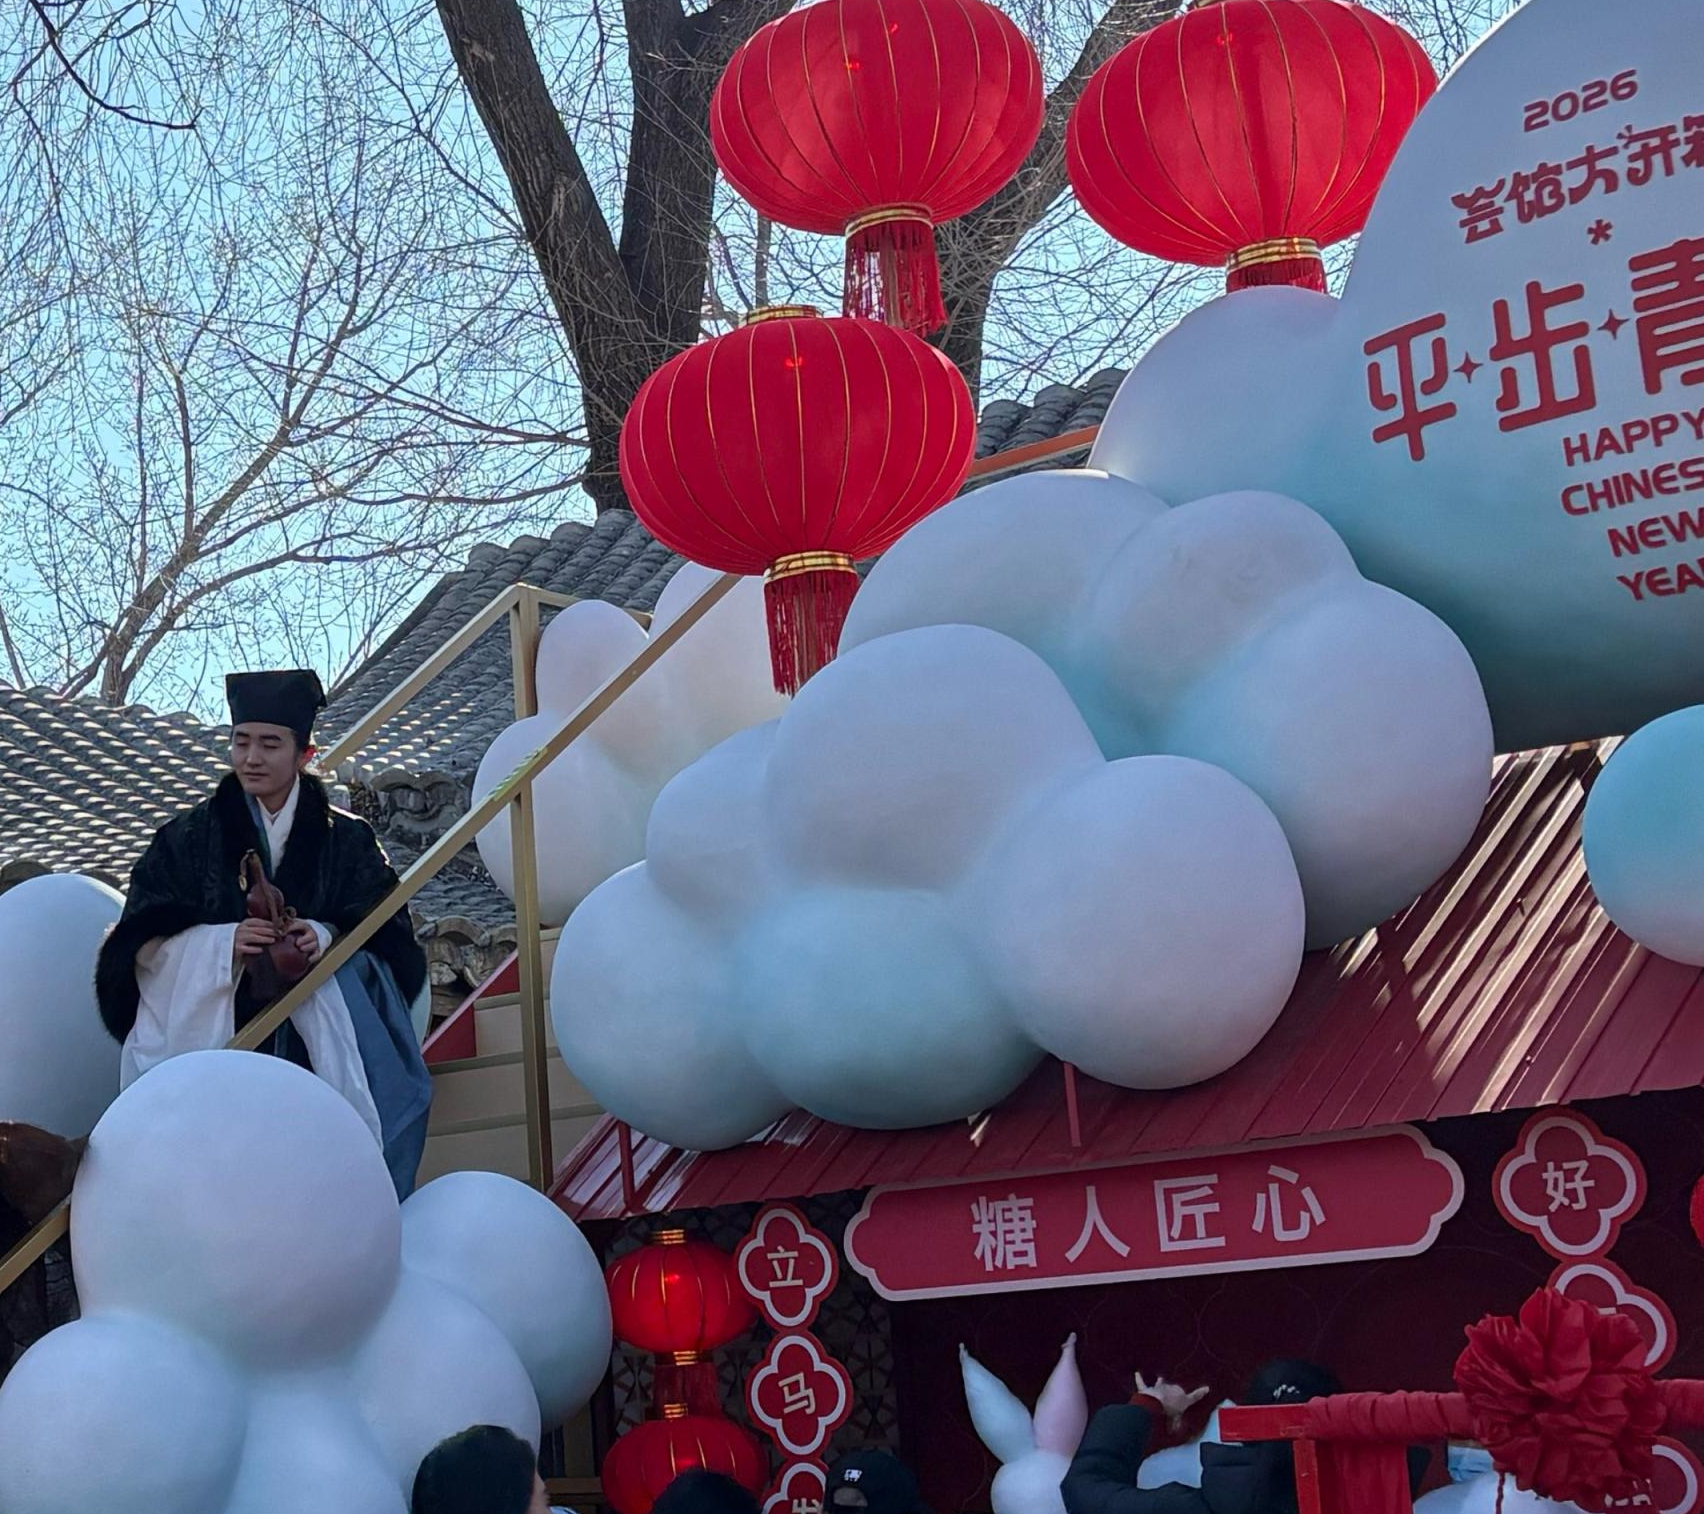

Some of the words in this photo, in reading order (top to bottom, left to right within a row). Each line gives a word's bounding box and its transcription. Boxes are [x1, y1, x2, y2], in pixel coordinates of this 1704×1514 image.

[1522, 68, 1639, 133] 2026
[1561, 407, 1704, 468] HAPPY
[1606, 507, 1704, 558] NEW
[1541, 1159, 1596, 1213] 好
[969, 1163, 1327, 1272] 糖人匠心
